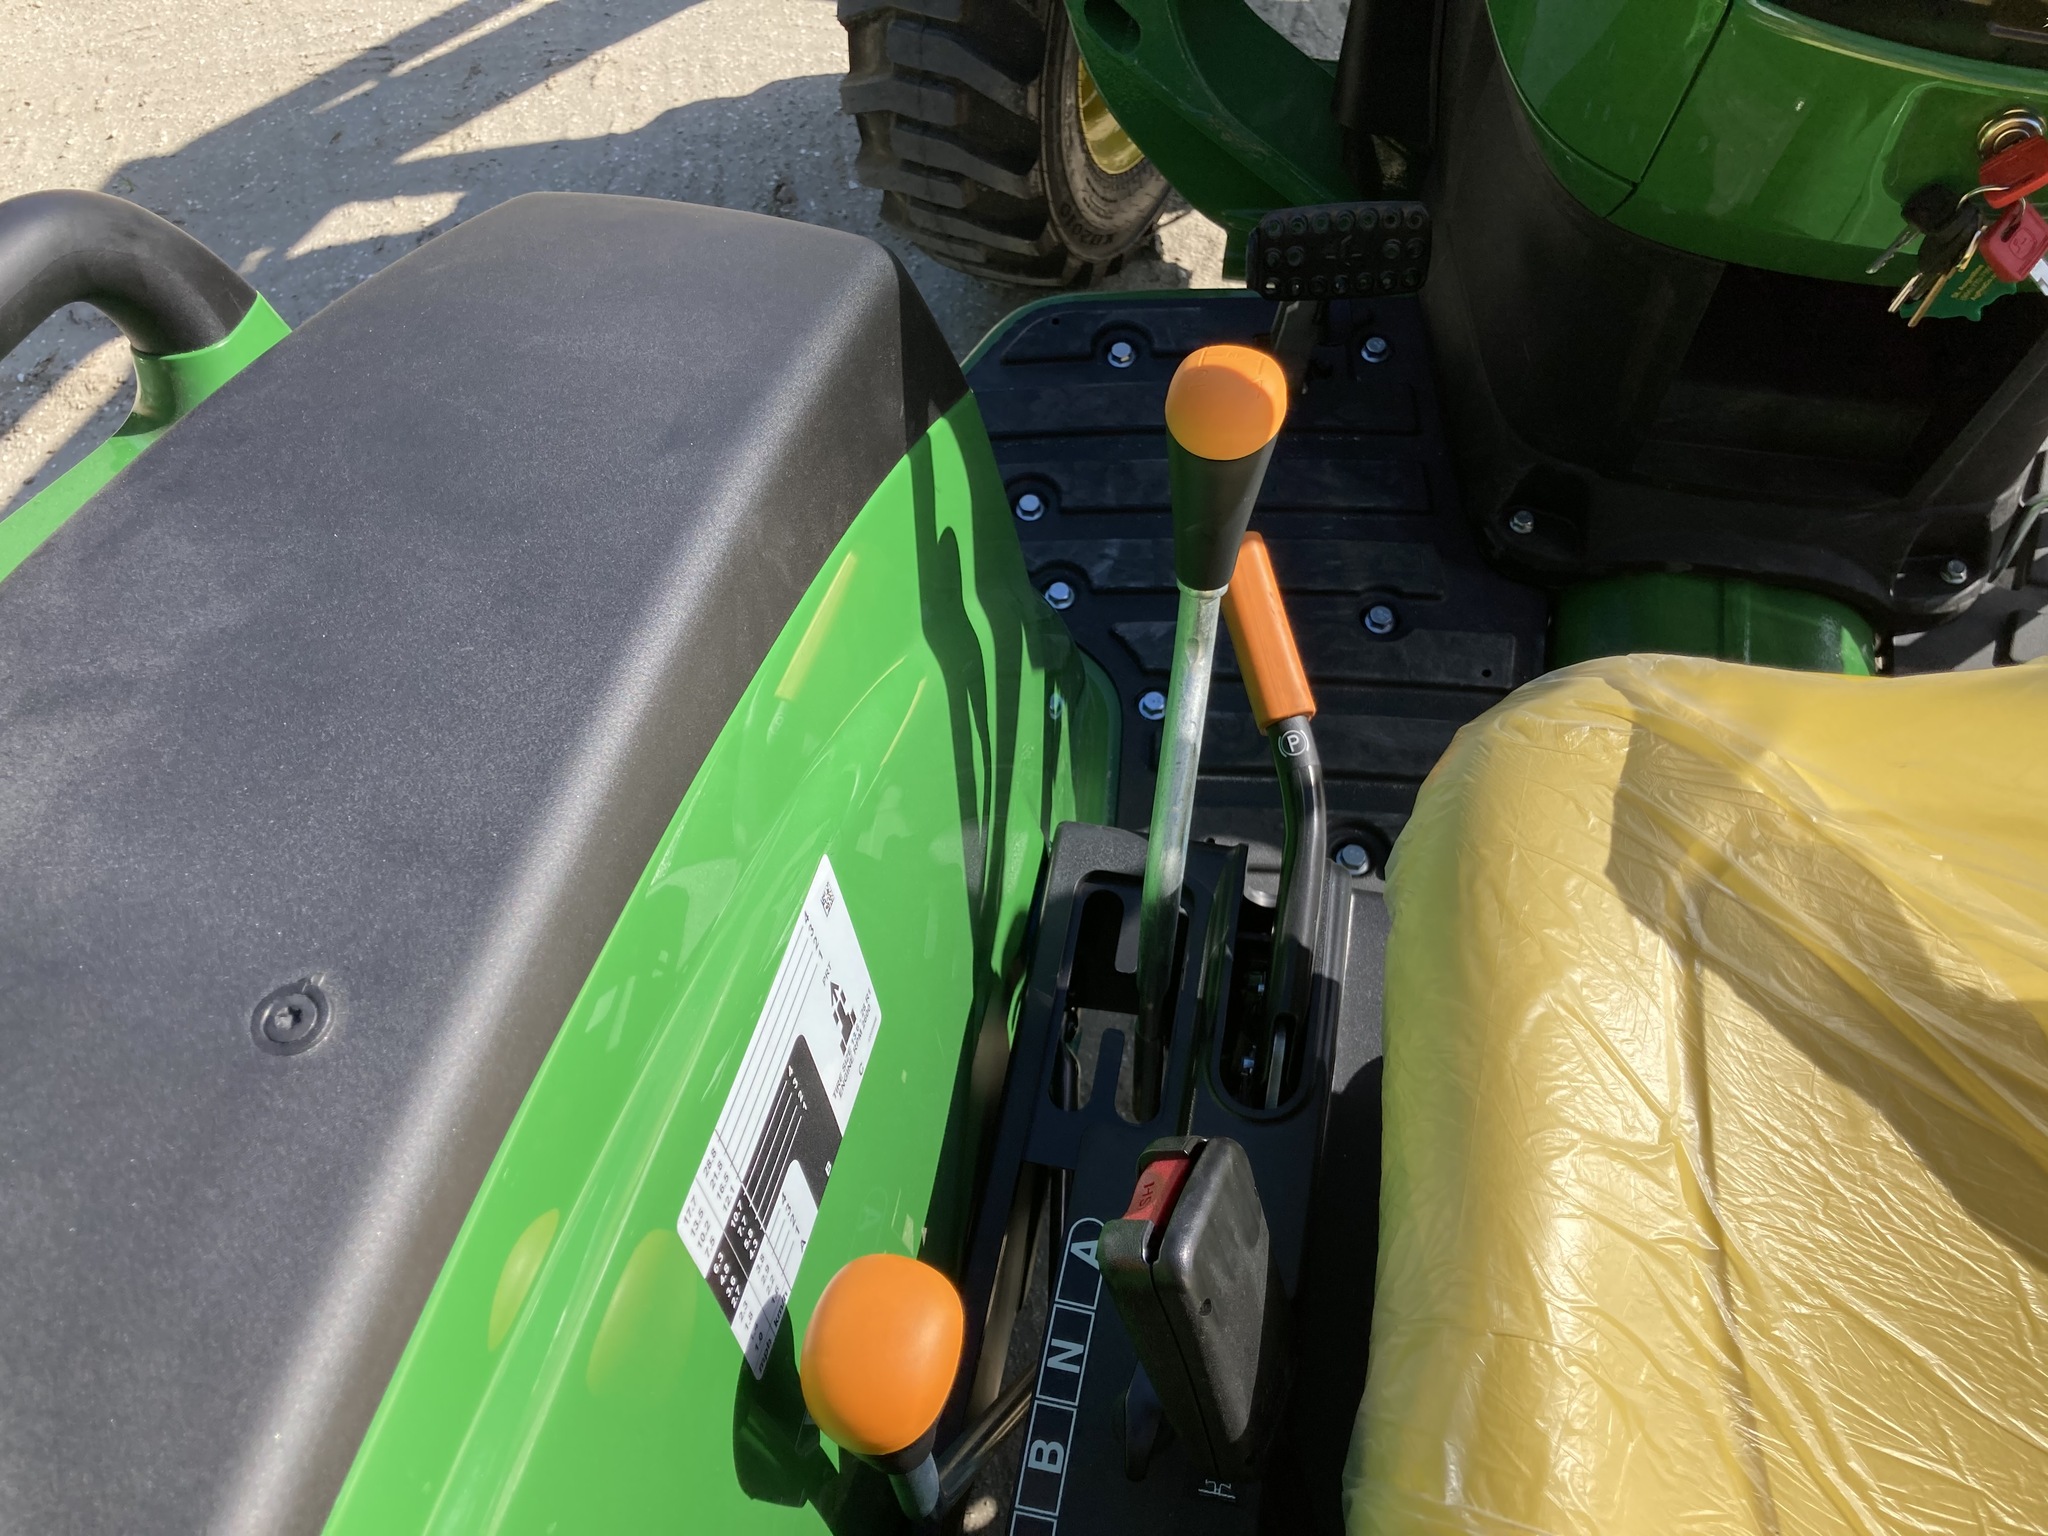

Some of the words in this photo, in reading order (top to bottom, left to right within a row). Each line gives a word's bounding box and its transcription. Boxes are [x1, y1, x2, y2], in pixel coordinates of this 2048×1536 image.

[1286, 734, 1299, 752] P
[832, 1072, 843, 1099] TIRE
[841, 1046, 852, 1073] SIZE
[838, 1057, 854, 1098] ENGINE
[852, 1028, 863, 1054] RPM
[858, 1062, 864, 1076] C
[824, 1160, 832, 1177] B
[800, 1239, 807, 1253] A
[759, 1338, 772, 1372] mph
[773, 1291, 788, 1328] km/h
[1028, 1439, 1065, 1474] B
[1047, 1340, 1085, 1374] N
[1070, 1239, 1101, 1271] A
